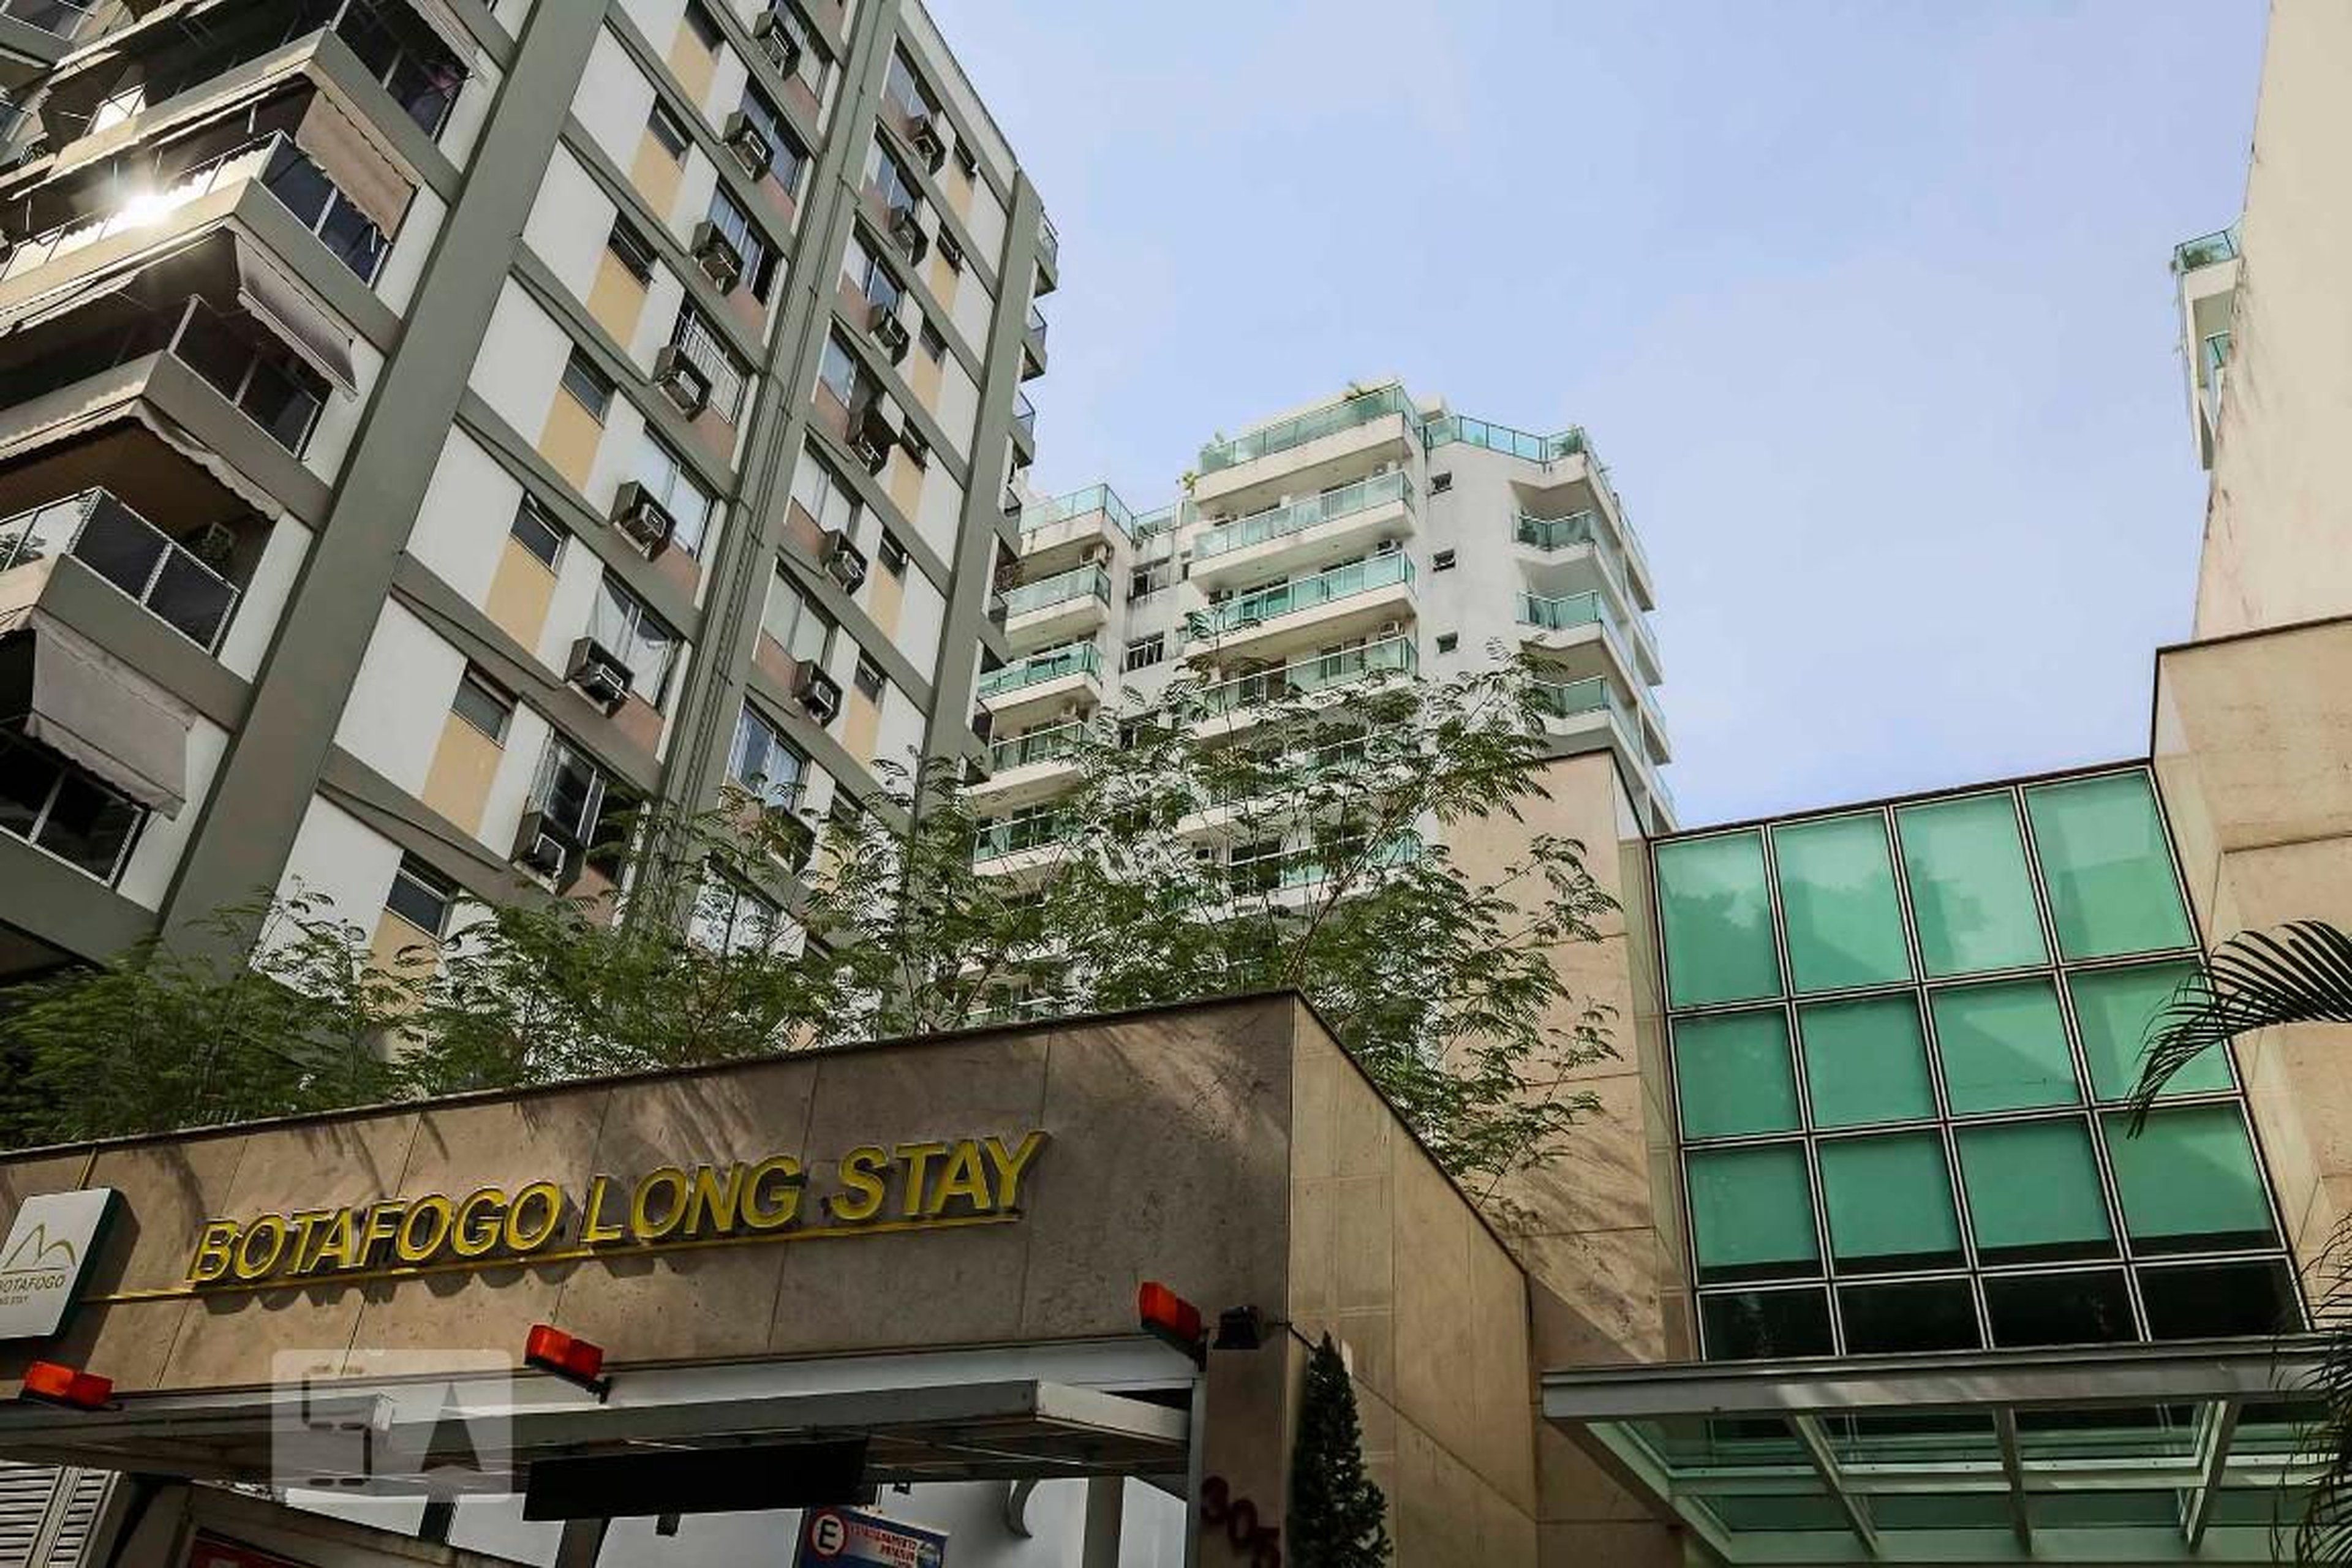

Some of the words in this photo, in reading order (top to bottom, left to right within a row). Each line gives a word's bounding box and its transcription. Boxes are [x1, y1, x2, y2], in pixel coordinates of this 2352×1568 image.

[185, 1181, 564, 1283] BOTAFOGO
[580, 1155, 804, 1243] LONG
[832, 1129, 1052, 1221] STAY
[818, 1519, 839, 1550] E
